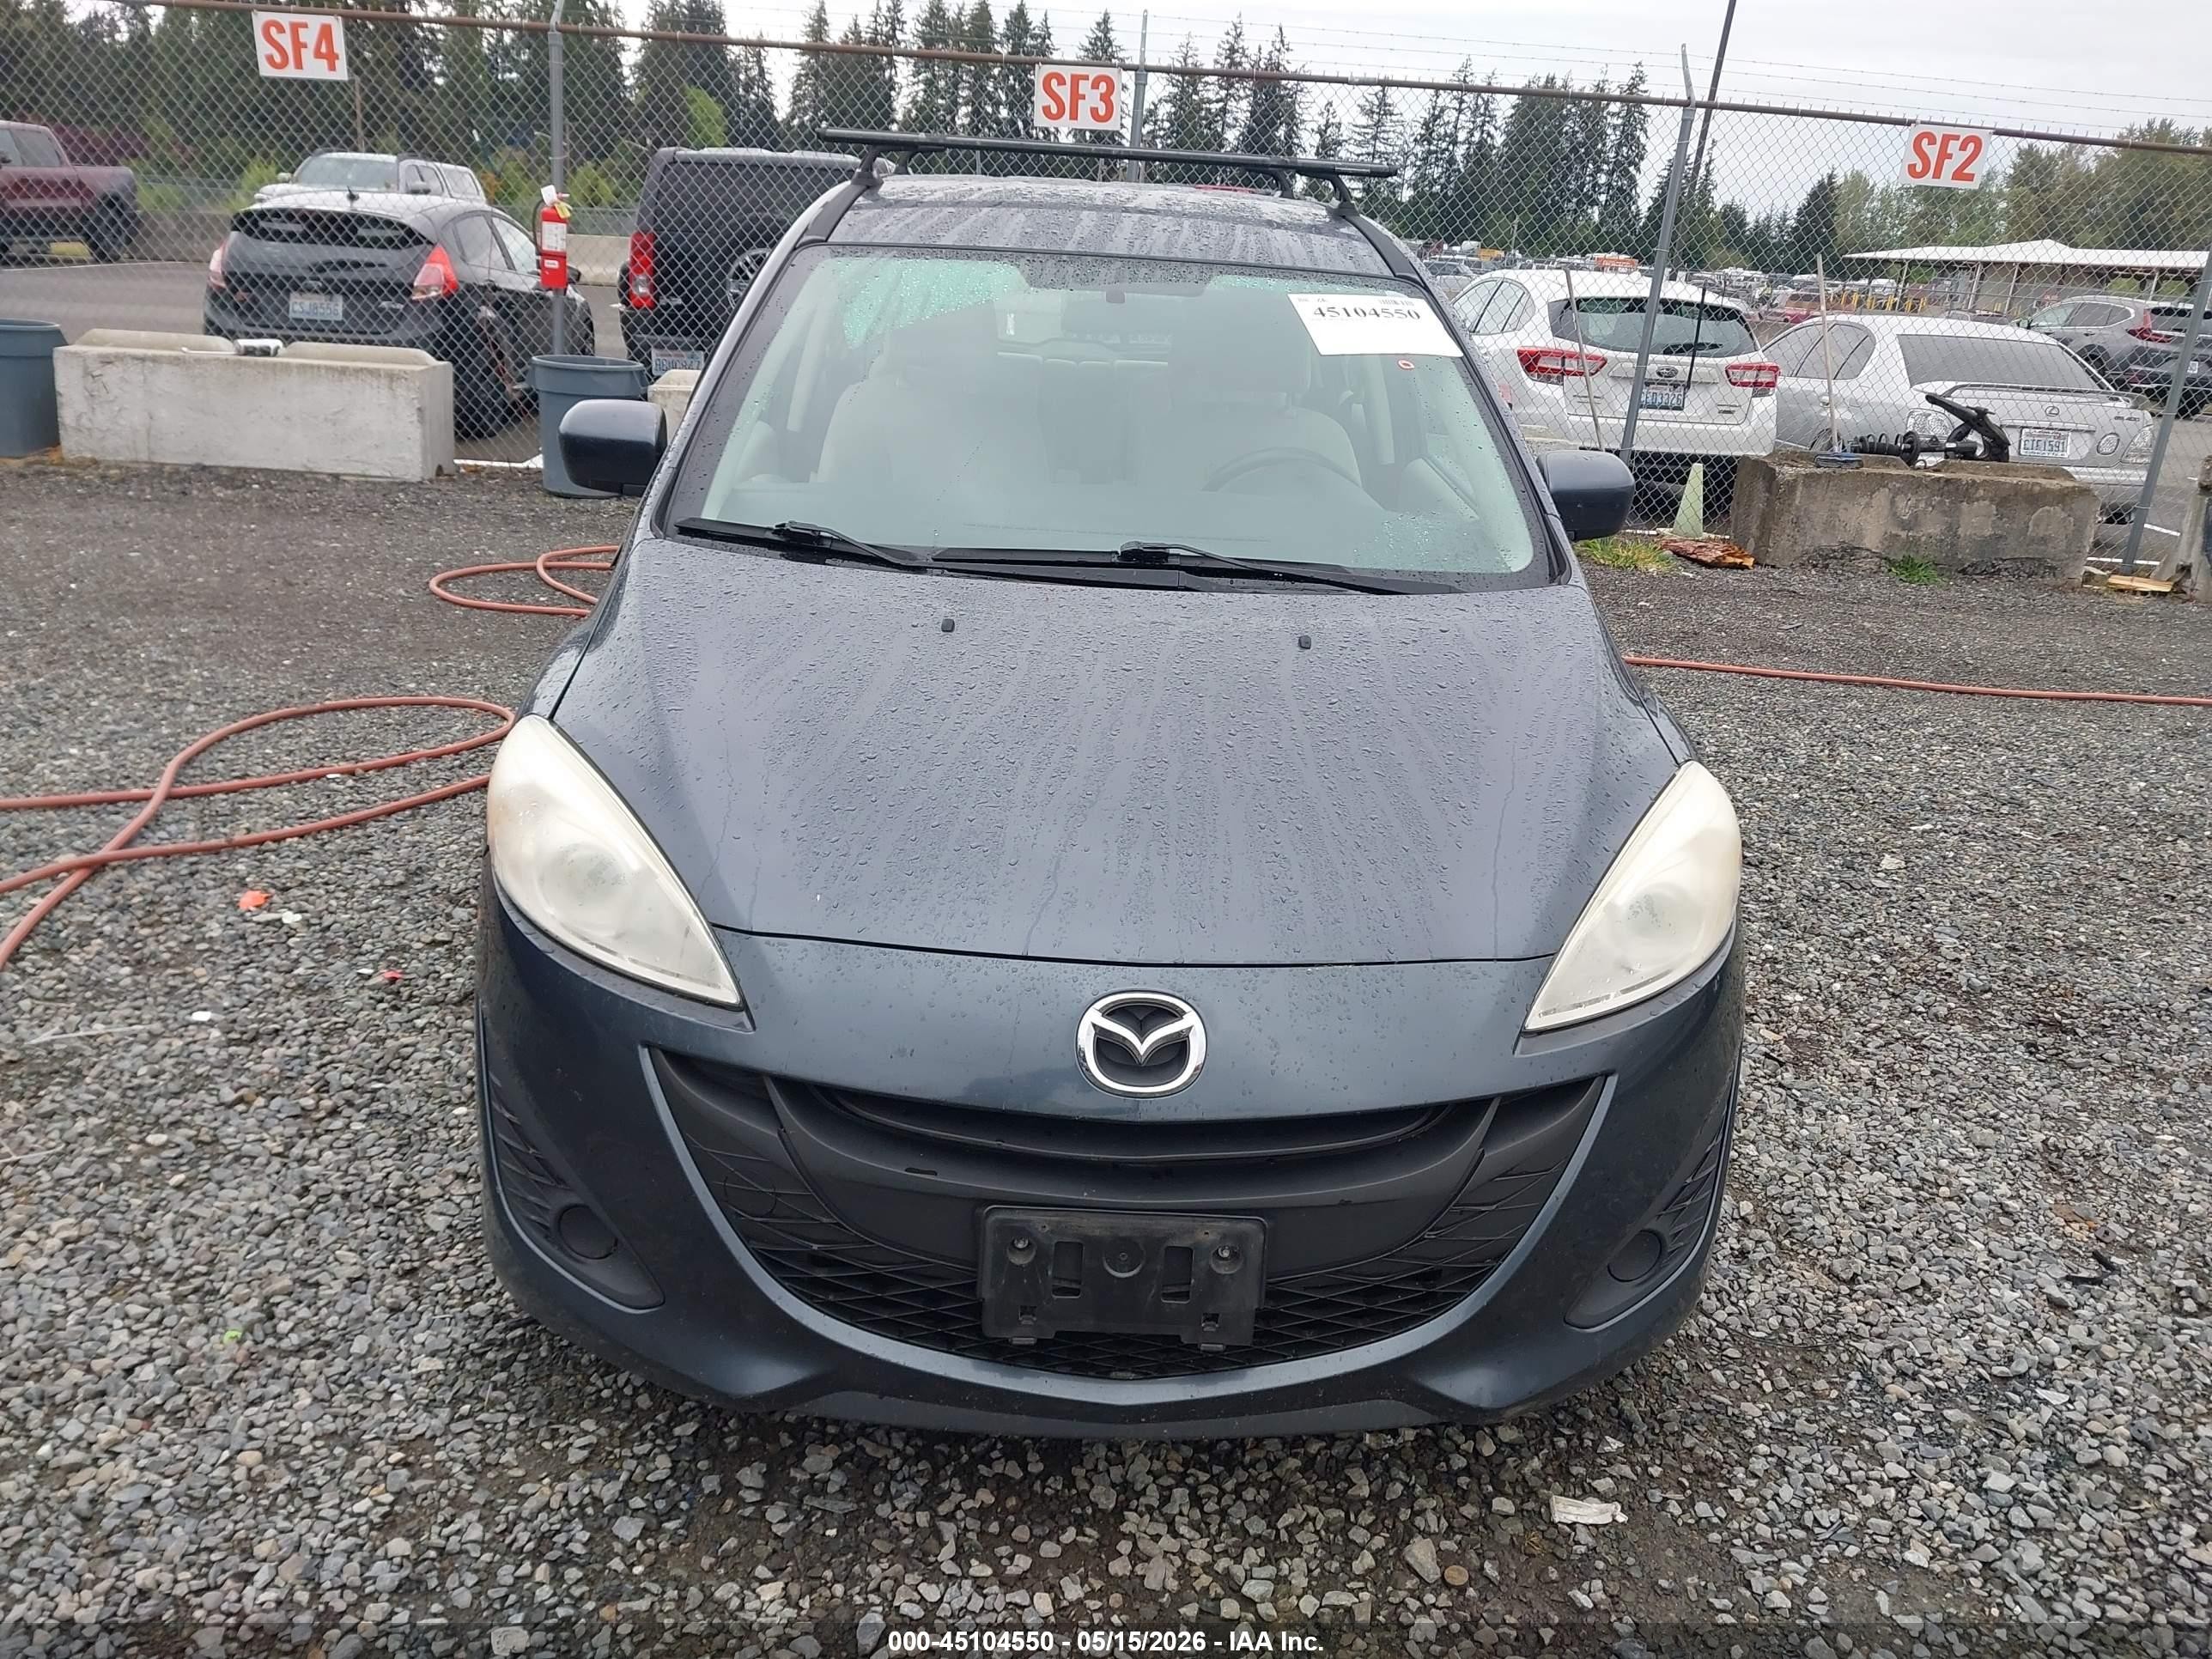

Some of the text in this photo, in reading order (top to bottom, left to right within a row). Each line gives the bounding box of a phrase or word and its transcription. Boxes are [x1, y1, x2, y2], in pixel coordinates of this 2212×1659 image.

[262, 21, 337, 71] SF4
[1042, 72, 1115, 122] SF3
[1908, 131, 1983, 181] SF2
[1313, 307, 1421, 319] 45104550
